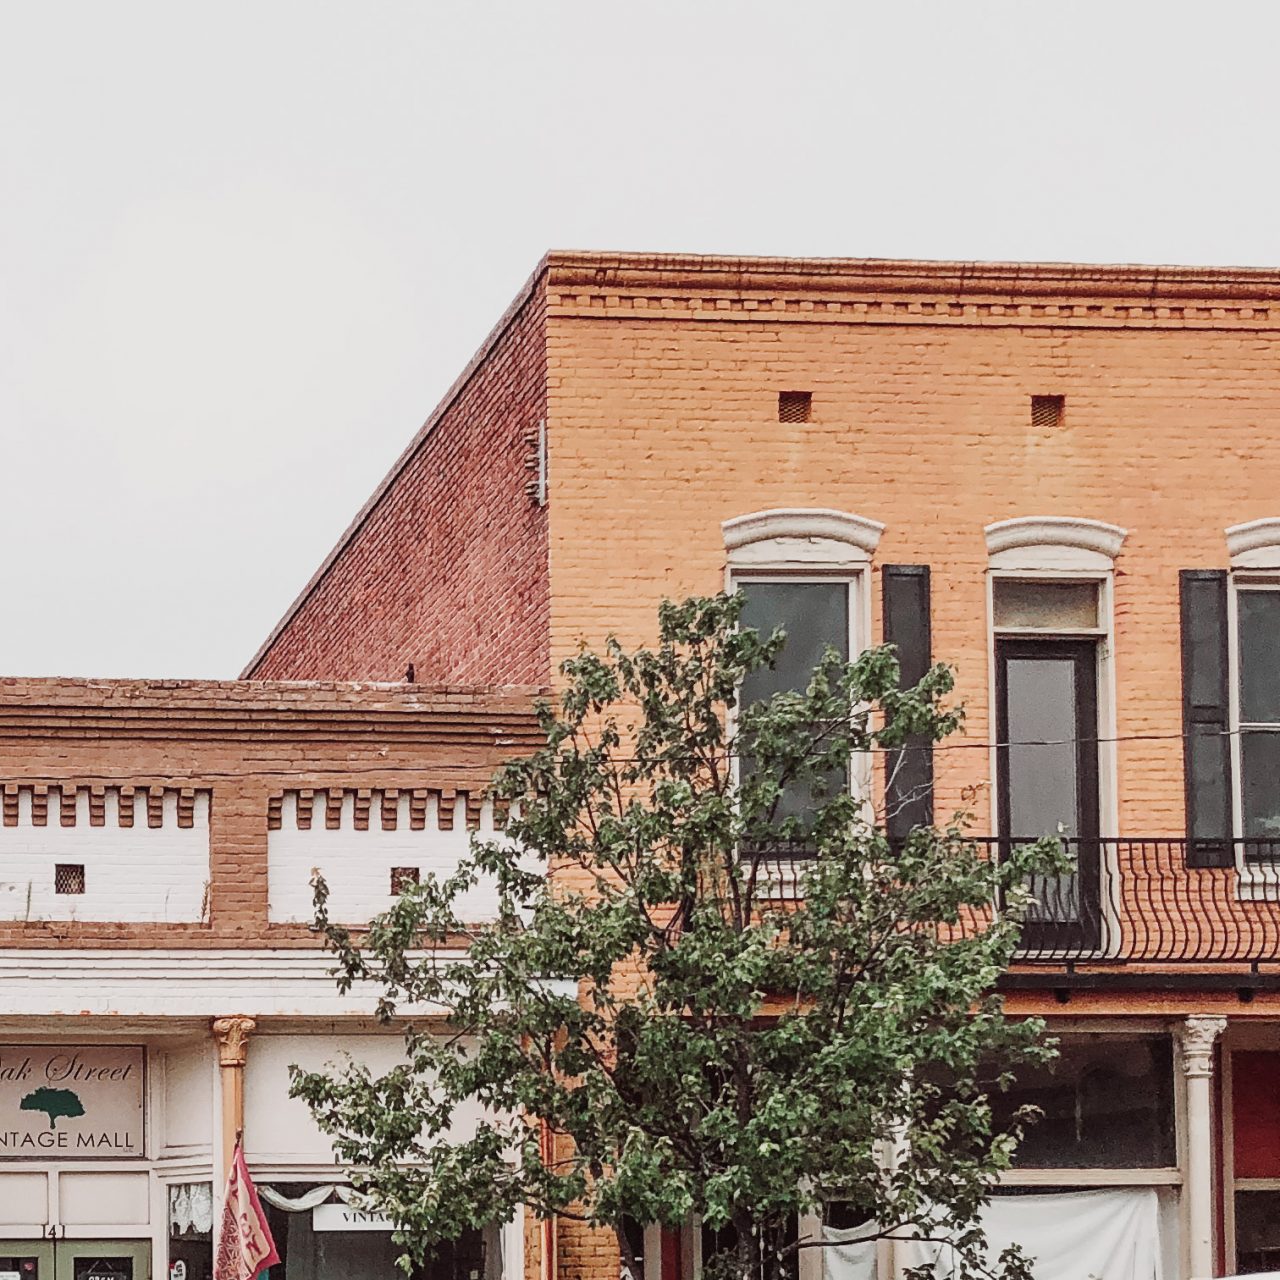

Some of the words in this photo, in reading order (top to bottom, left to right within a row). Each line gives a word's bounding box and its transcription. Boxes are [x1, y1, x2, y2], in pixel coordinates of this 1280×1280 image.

[45, 1053, 133, 1082] Street
[76, 1131, 134, 1148] MALL
[342, 1212, 391, 1223] VINTA
